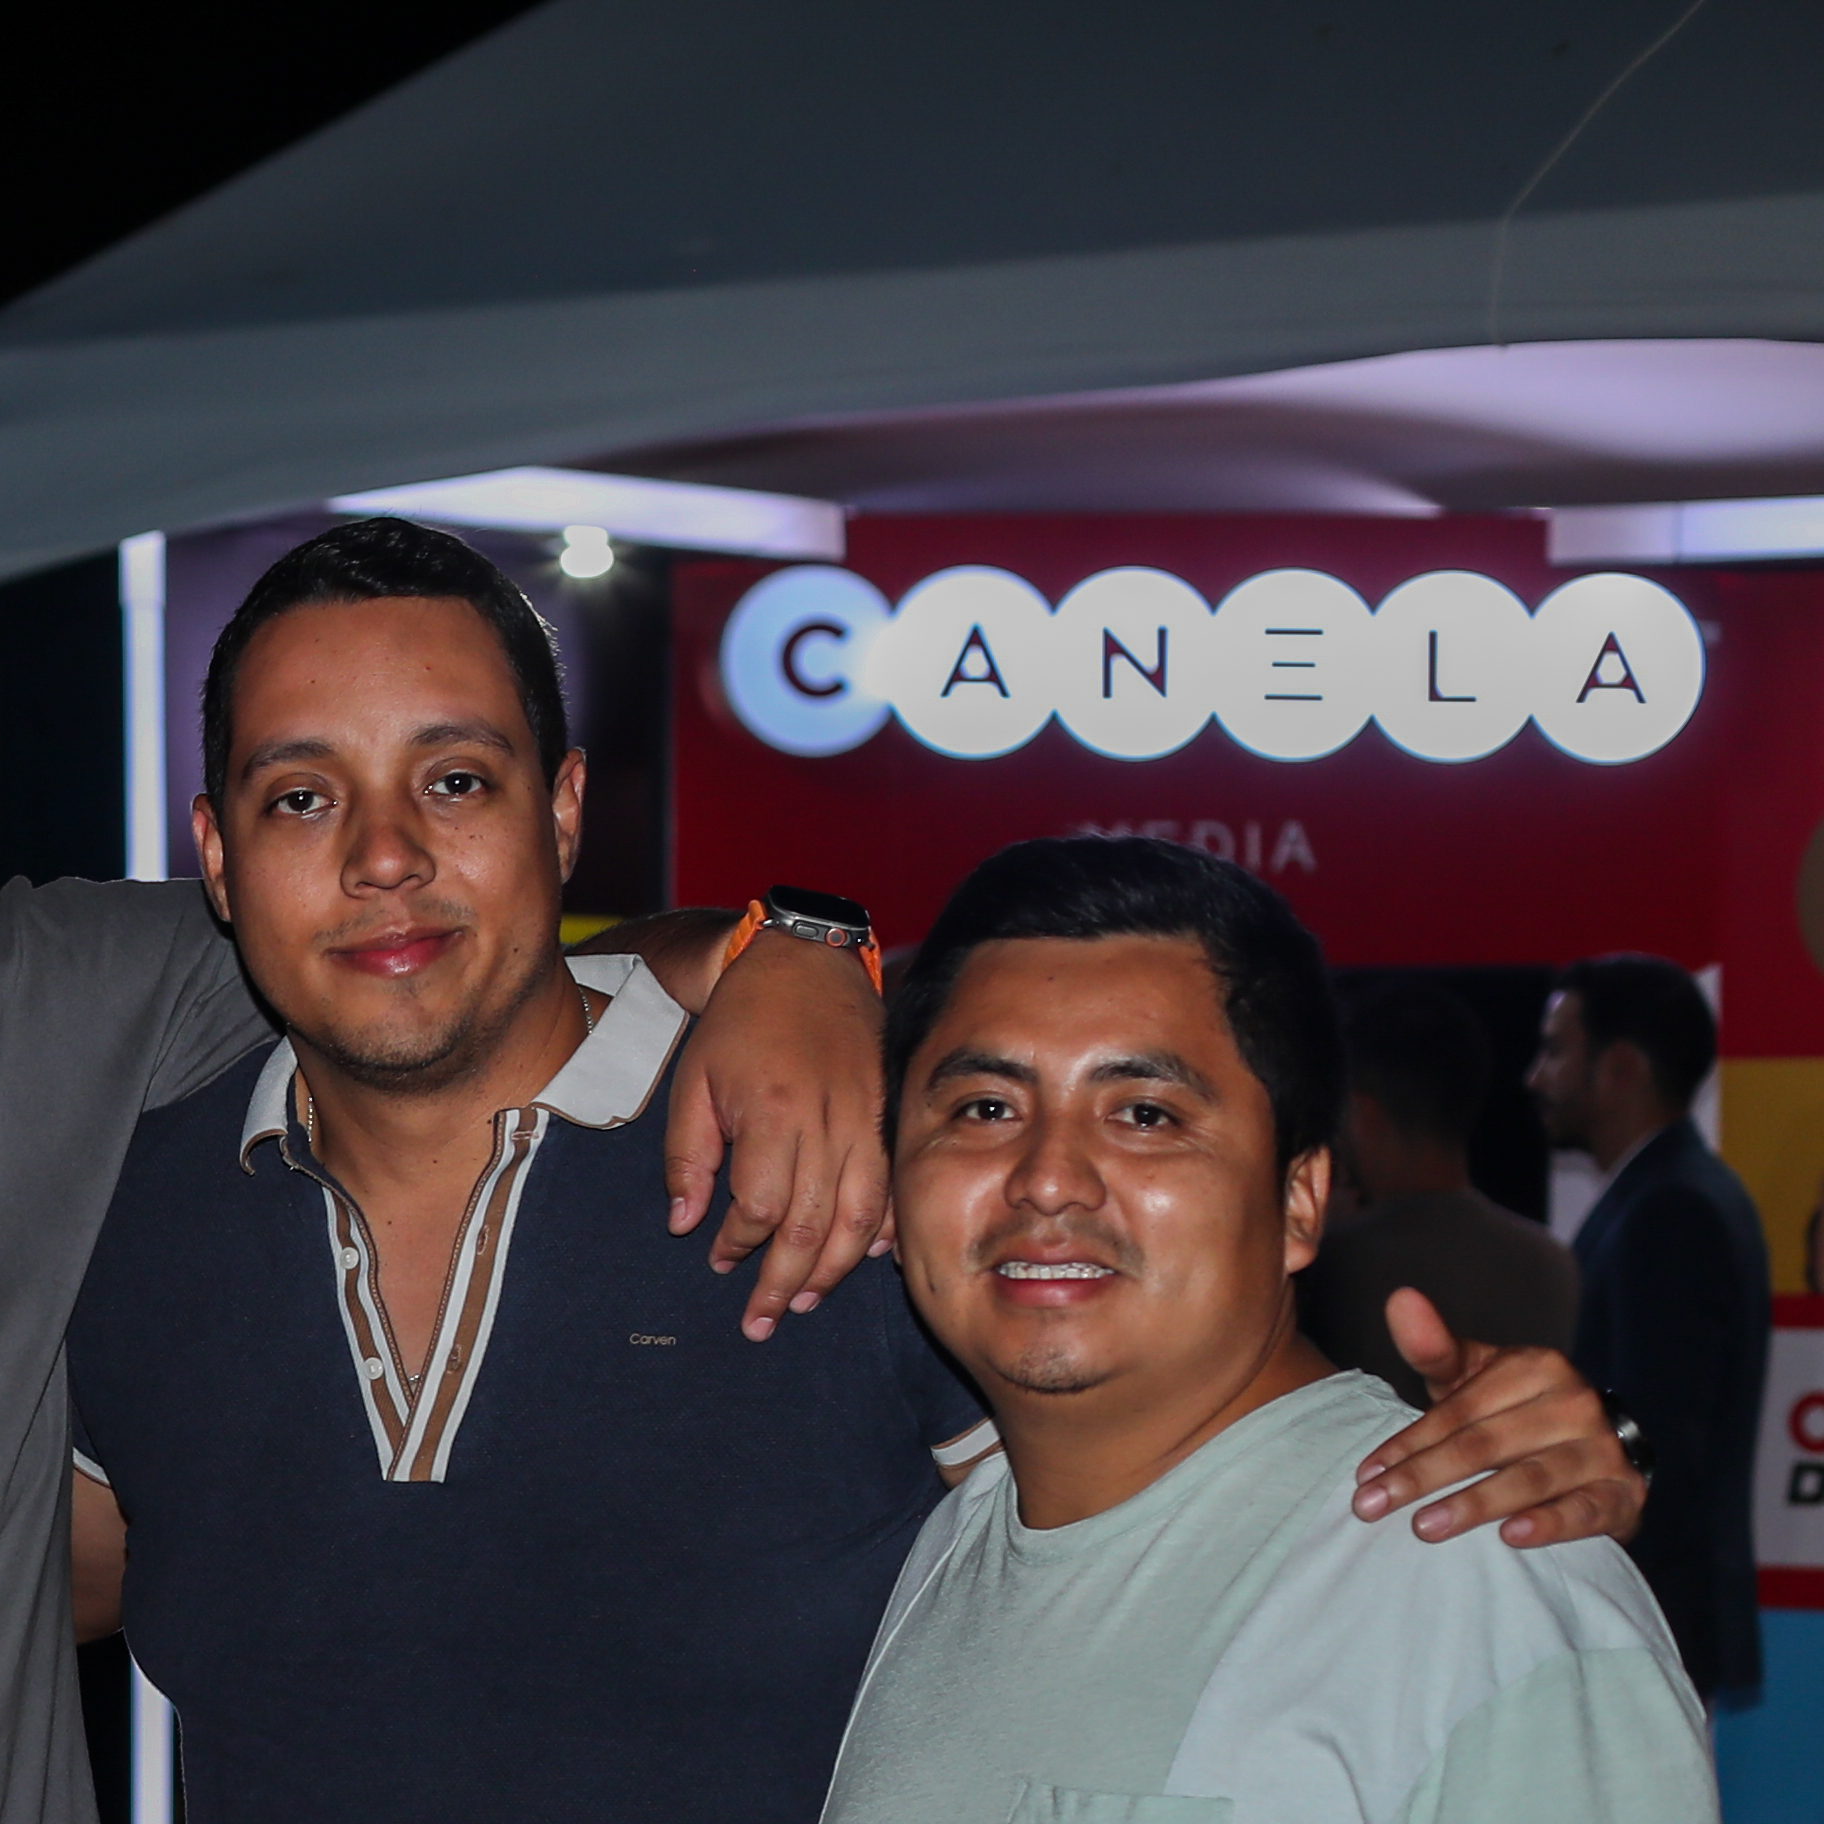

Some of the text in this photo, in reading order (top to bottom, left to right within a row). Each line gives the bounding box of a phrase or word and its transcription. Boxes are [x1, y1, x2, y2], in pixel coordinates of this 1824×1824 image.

[780, 621, 1648, 705] CANELA
[1068, 818, 1318, 874] DIA
[628, 1332, 677, 1346] Carven
